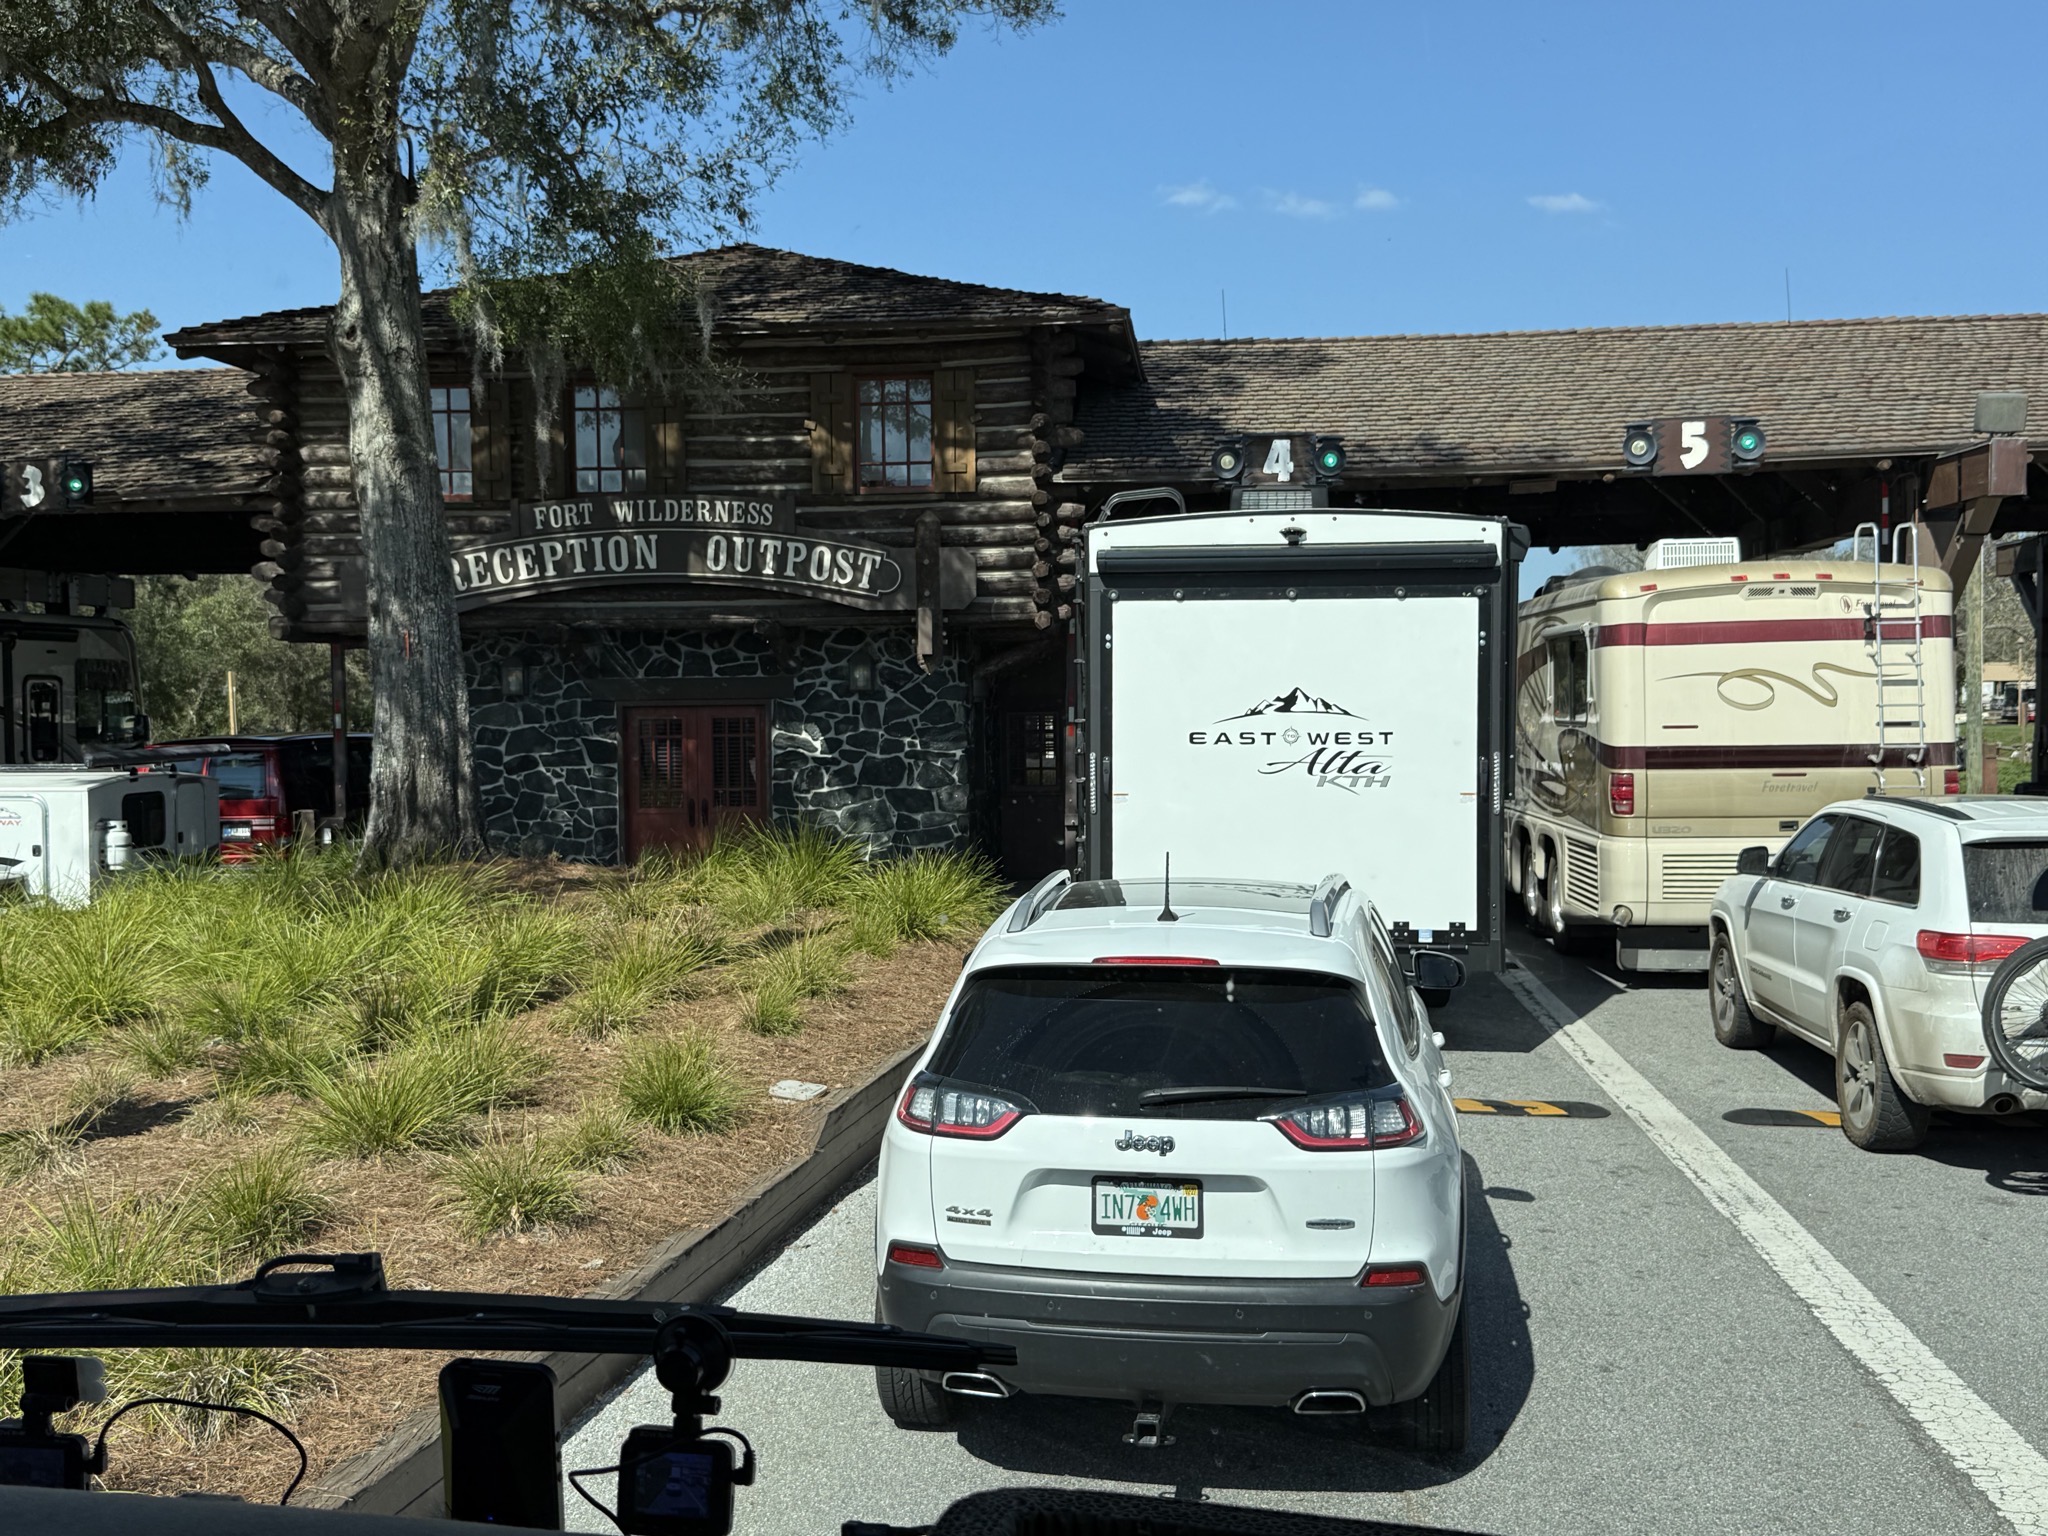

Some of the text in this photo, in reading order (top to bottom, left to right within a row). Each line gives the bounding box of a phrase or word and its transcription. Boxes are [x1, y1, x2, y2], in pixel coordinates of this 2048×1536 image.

[1679, 421, 1710, 469] 5
[1262, 439, 1294, 482] 4
[20, 464, 45, 508] 3
[533, 499, 774, 529] FORT WILDERNESS
[706, 535, 882, 590] OUTPOST
[1188, 731, 1277, 746] EAST
[1306, 731, 1394, 746] WEST
[1257, 747, 1394, 777] Alta
[1316, 775, 1392, 796] KTH
[1761, 780, 1819, 793] Foretravel
[1114, 1129, 1176, 1157] Jeep
[1152, 1228, 1172, 1237] Jeep
